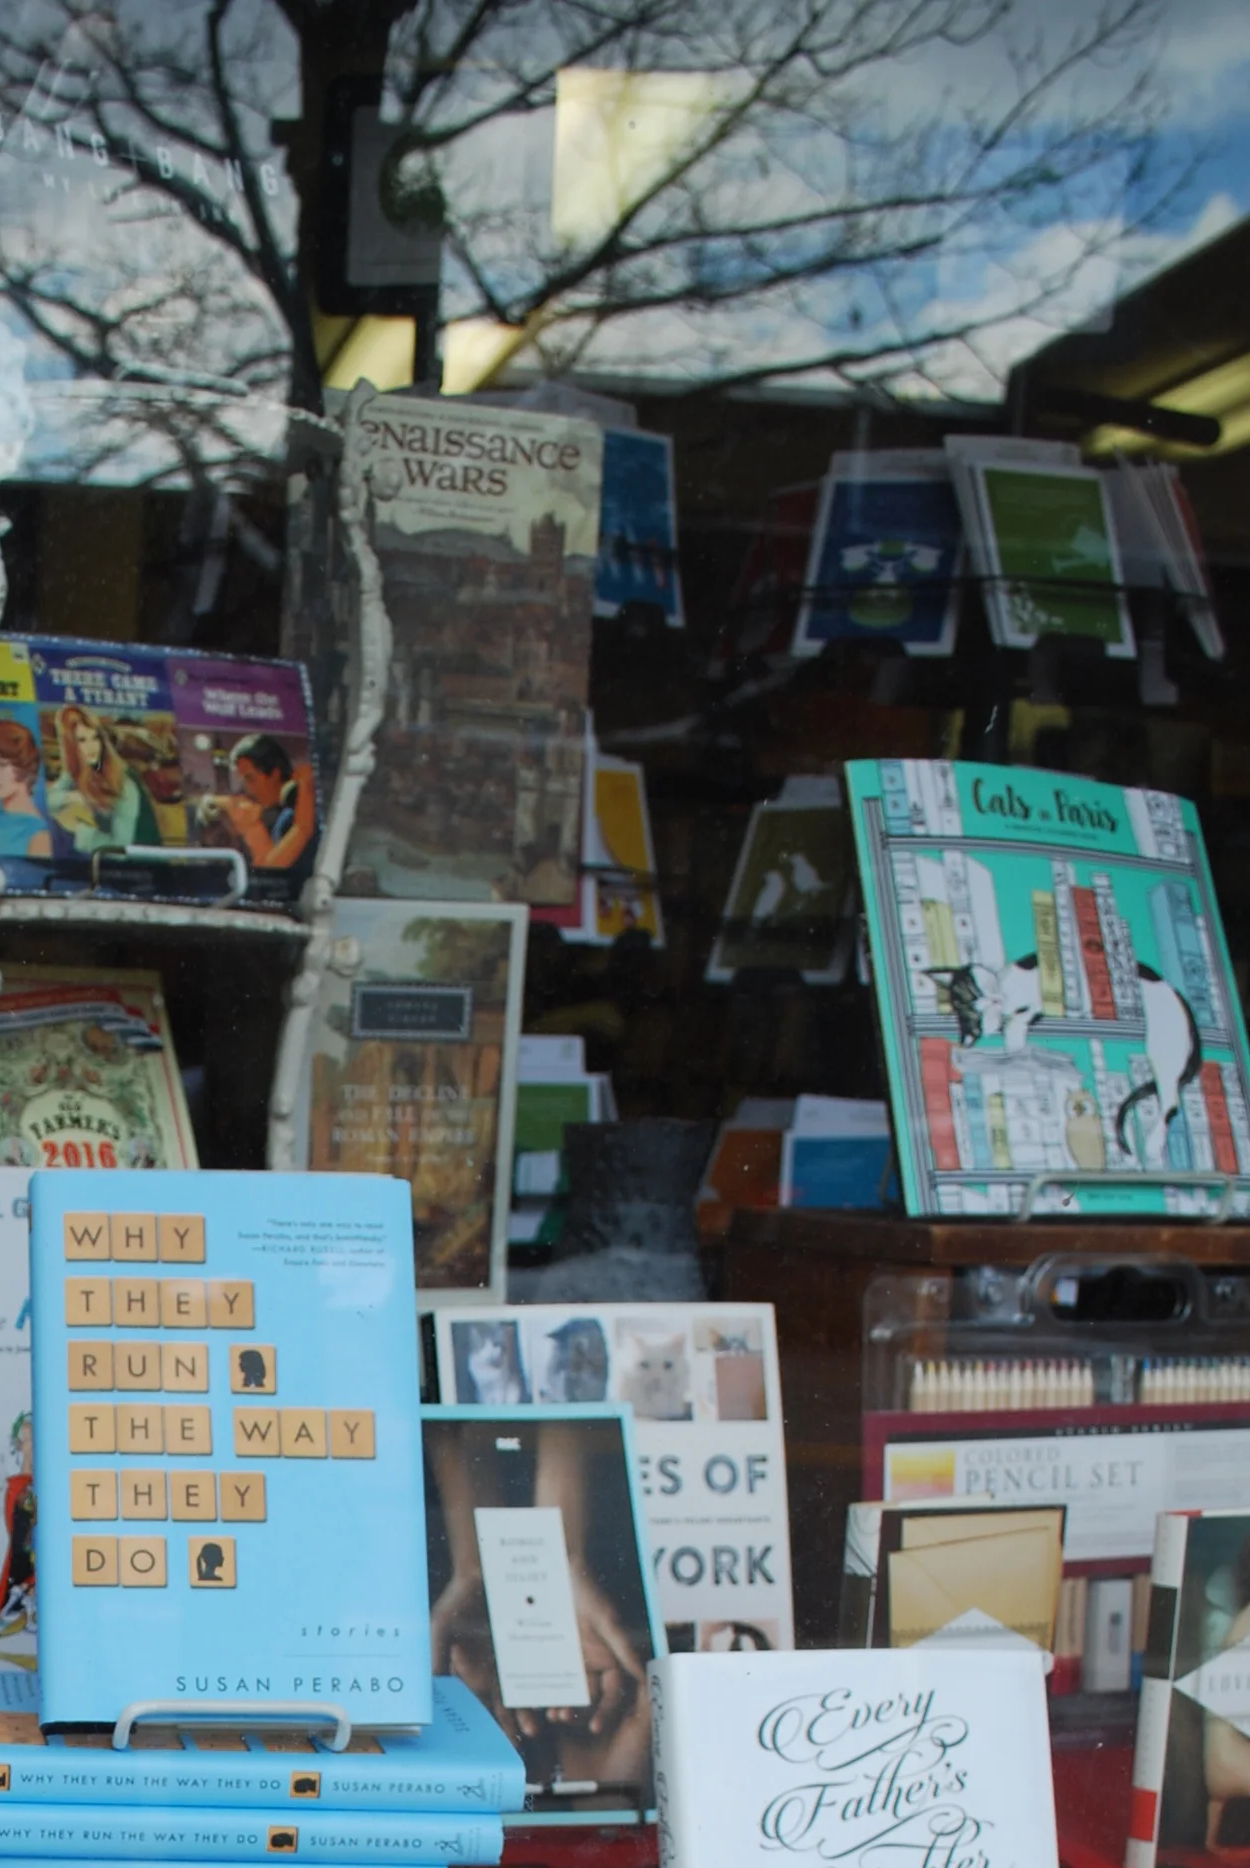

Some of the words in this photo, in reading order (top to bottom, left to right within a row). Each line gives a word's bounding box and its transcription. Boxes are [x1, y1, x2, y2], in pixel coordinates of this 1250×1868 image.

[971, 778, 1031, 821] Cats
[1053, 789, 1117, 834] Paris
[965, 1466, 1076, 1494] PENCIL
[1090, 1461, 1142, 1488] SET
[758, 1688, 968, 1772] Every
[20, 1773, 53, 1784] WHY
[63, 1774, 98, 1785] THEY
[106, 1776, 135, 1786] RUN
[144, 1777, 168, 1787] THE
[177, 1777, 209, 1788] WAY
[217, 1778, 251, 1790] THEY
[259, 1780, 282, 1790] DO
[332, 1781, 382, 1792] SUSAN
[388, 1782, 446, 1794] PERABO
[759, 1751, 968, 1857] Father's
